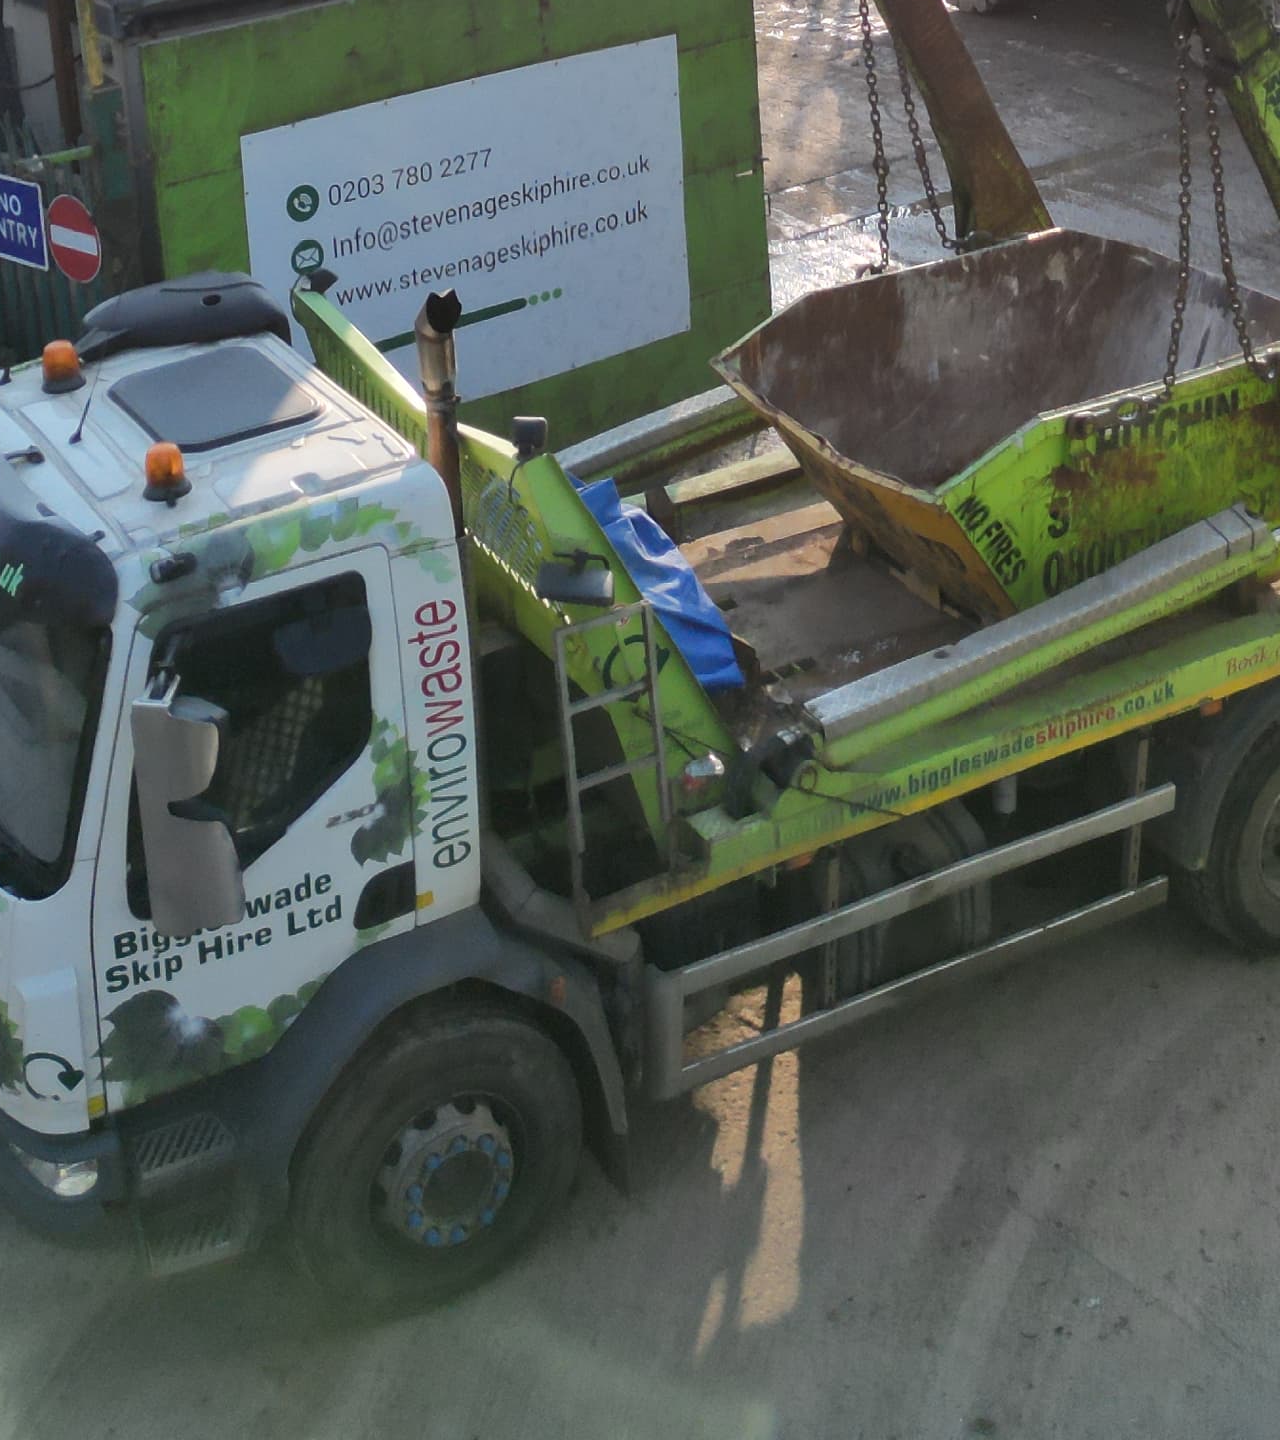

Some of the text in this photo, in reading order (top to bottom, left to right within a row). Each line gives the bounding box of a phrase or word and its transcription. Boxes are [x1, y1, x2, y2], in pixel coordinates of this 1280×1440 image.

[328, 148, 492, 207] 0203 780 2277
[332, 154, 651, 260] Info@stevenageskiphire.co.uk
[336, 200, 649, 307] www.stevenageskiphire.co.uk
[955, 496, 1026, 586] NO FIRES
[407, 599, 472, 869] envirowaste
[849, 680, 1176, 819] www.biggleswadeskiphire.co.uk
[105, 894, 343, 993] Skip Hire Ltd
[113, 872, 332, 960] Bigwade
